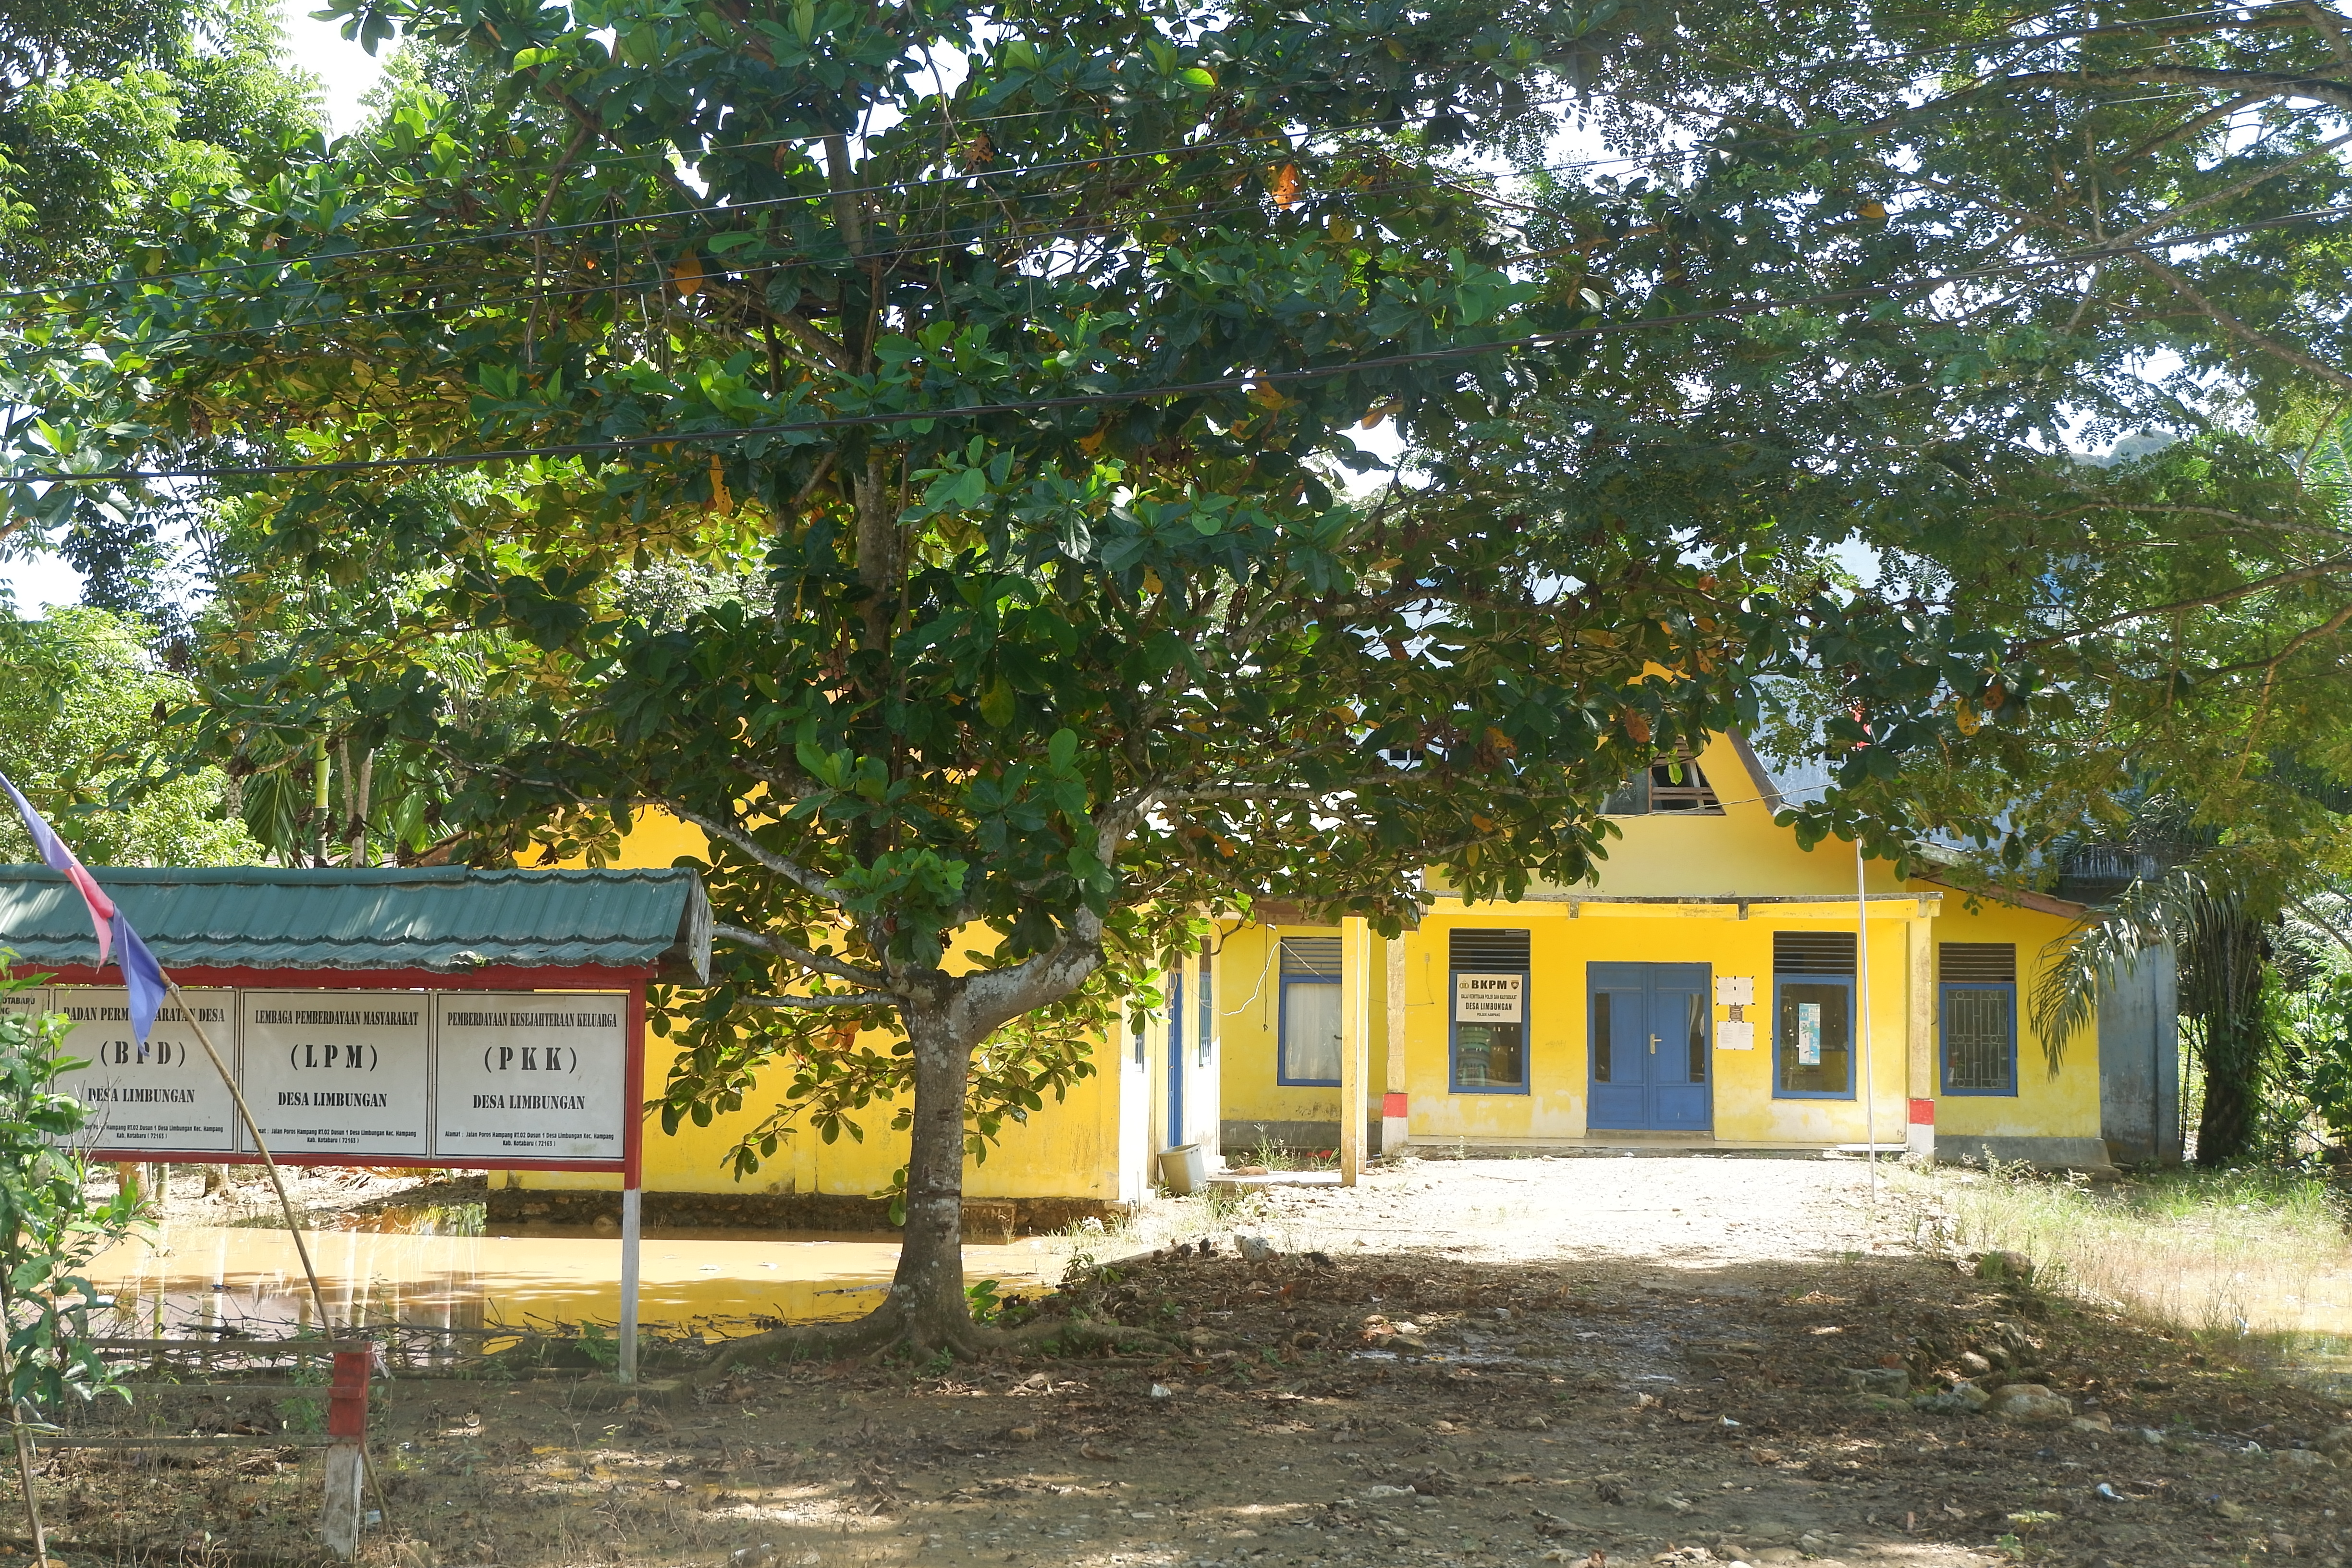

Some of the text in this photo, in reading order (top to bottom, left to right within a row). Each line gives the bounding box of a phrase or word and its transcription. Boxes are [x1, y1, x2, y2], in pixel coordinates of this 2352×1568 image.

[1471, 980, 1507, 989] BKPM
[64, 1007, 97, 1021] BADAN
[199, 1008, 225, 1022] DESA
[256, 1010, 418, 1025] LEMBAGA PEMBERDAYAAN MASYARAKAT
[448, 1012, 617, 1027] PEMBERDAYAAN KESEJAHTERAAN KELUARGA
[88, 1088, 195, 1102] DESA LIMBUNGAN
[278, 1092, 387, 1107] DESA LIMBUNGAN
[473, 1095, 585, 1109] DESA LIMBUNGAN
